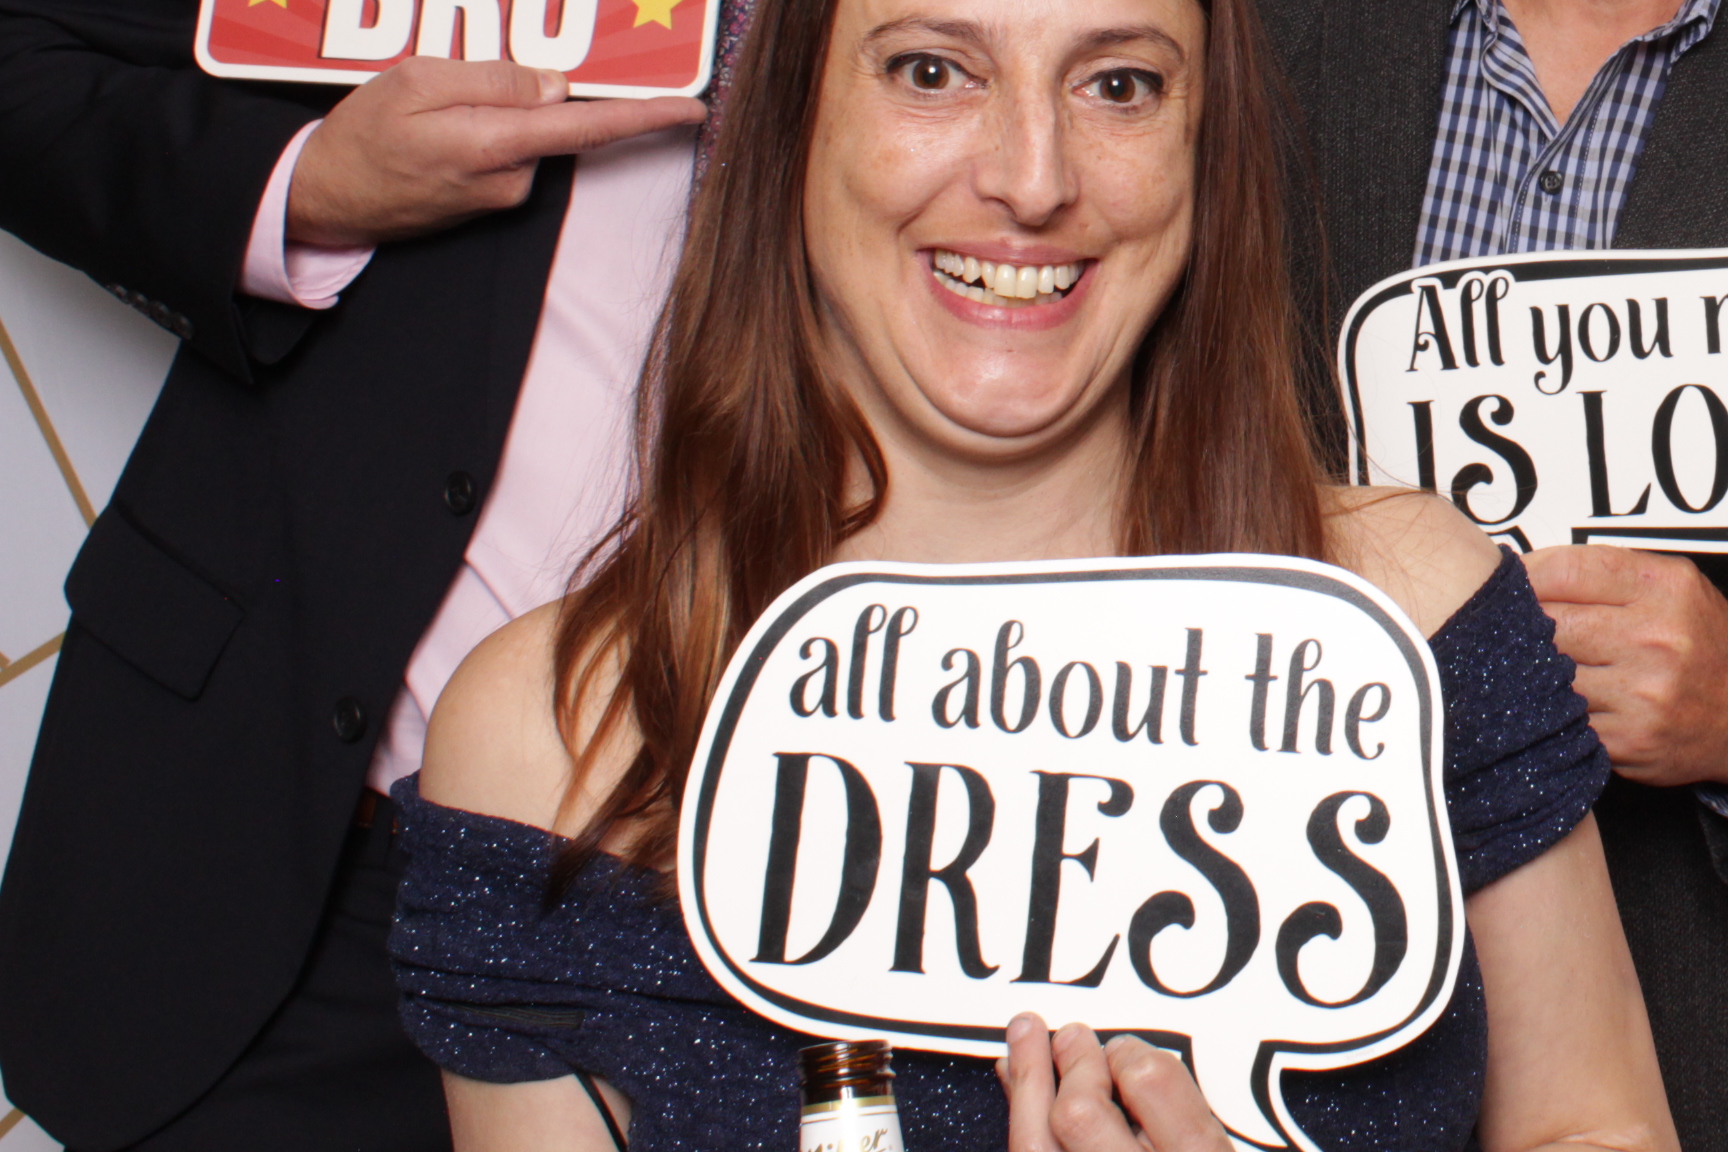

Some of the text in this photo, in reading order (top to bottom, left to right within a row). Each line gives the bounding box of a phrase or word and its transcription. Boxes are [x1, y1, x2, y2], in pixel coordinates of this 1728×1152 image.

[1405, 276, 1510, 372] All
[1529, 296, 1674, 395] you
[1406, 394, 1539, 525] IS
[789, 603, 1392, 760] all about the
[748, 751, 1409, 1009] DRESS
